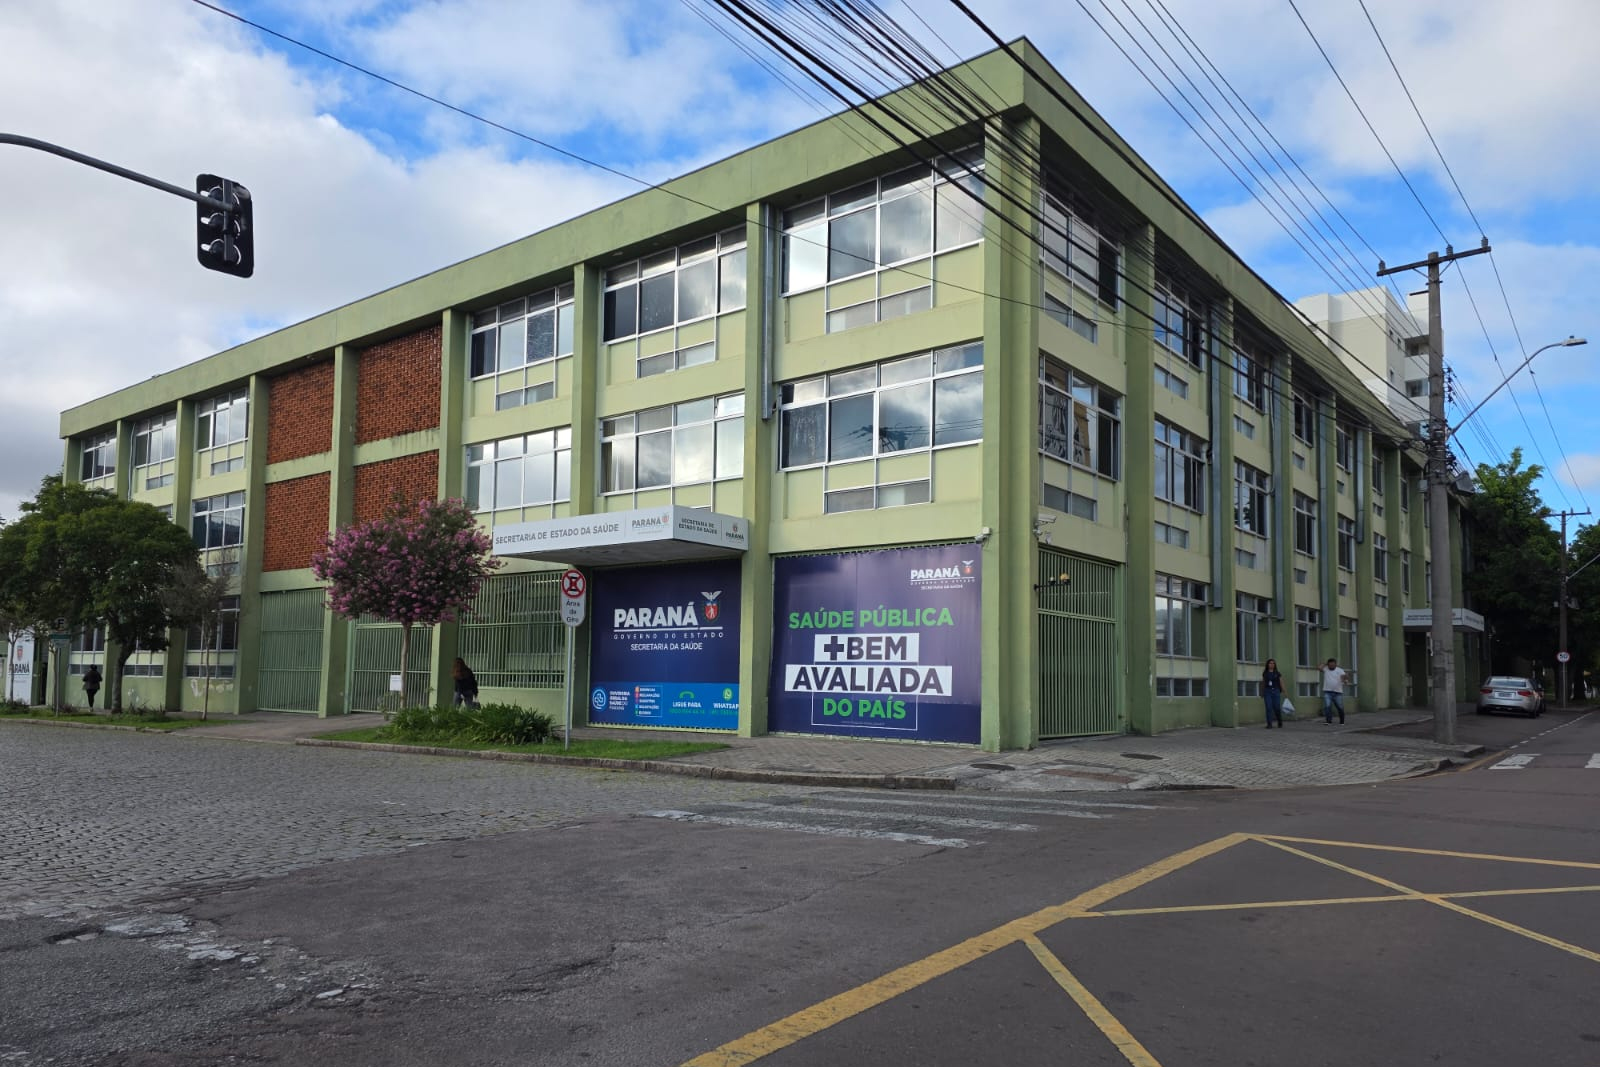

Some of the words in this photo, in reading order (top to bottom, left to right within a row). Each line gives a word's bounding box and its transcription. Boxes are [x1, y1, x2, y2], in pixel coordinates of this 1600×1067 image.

[495, 533, 537, 544] SECRETARIA
[537, 531, 548, 540] DE
[550, 529, 579, 539] ESTADO
[580, 527, 592, 536] DA
[592, 523, 620, 535] SAÚDE
[910, 565, 960, 579] PARANÁ
[614, 601, 699, 628] PARANÁ
[789, 607, 854, 629] SAÚDE
[859, 604, 954, 627] PÚBLICA
[630, 643, 669, 651] SECRETARIA
[669, 643, 679, 651] DA
[680, 641, 703, 650] SAÚDE
[683, 631, 724, 639] ESTADO
[792, 666, 944, 694] AVALIADA
[823, 698, 853, 716] DO
[859, 695, 906, 719] PAÍS
